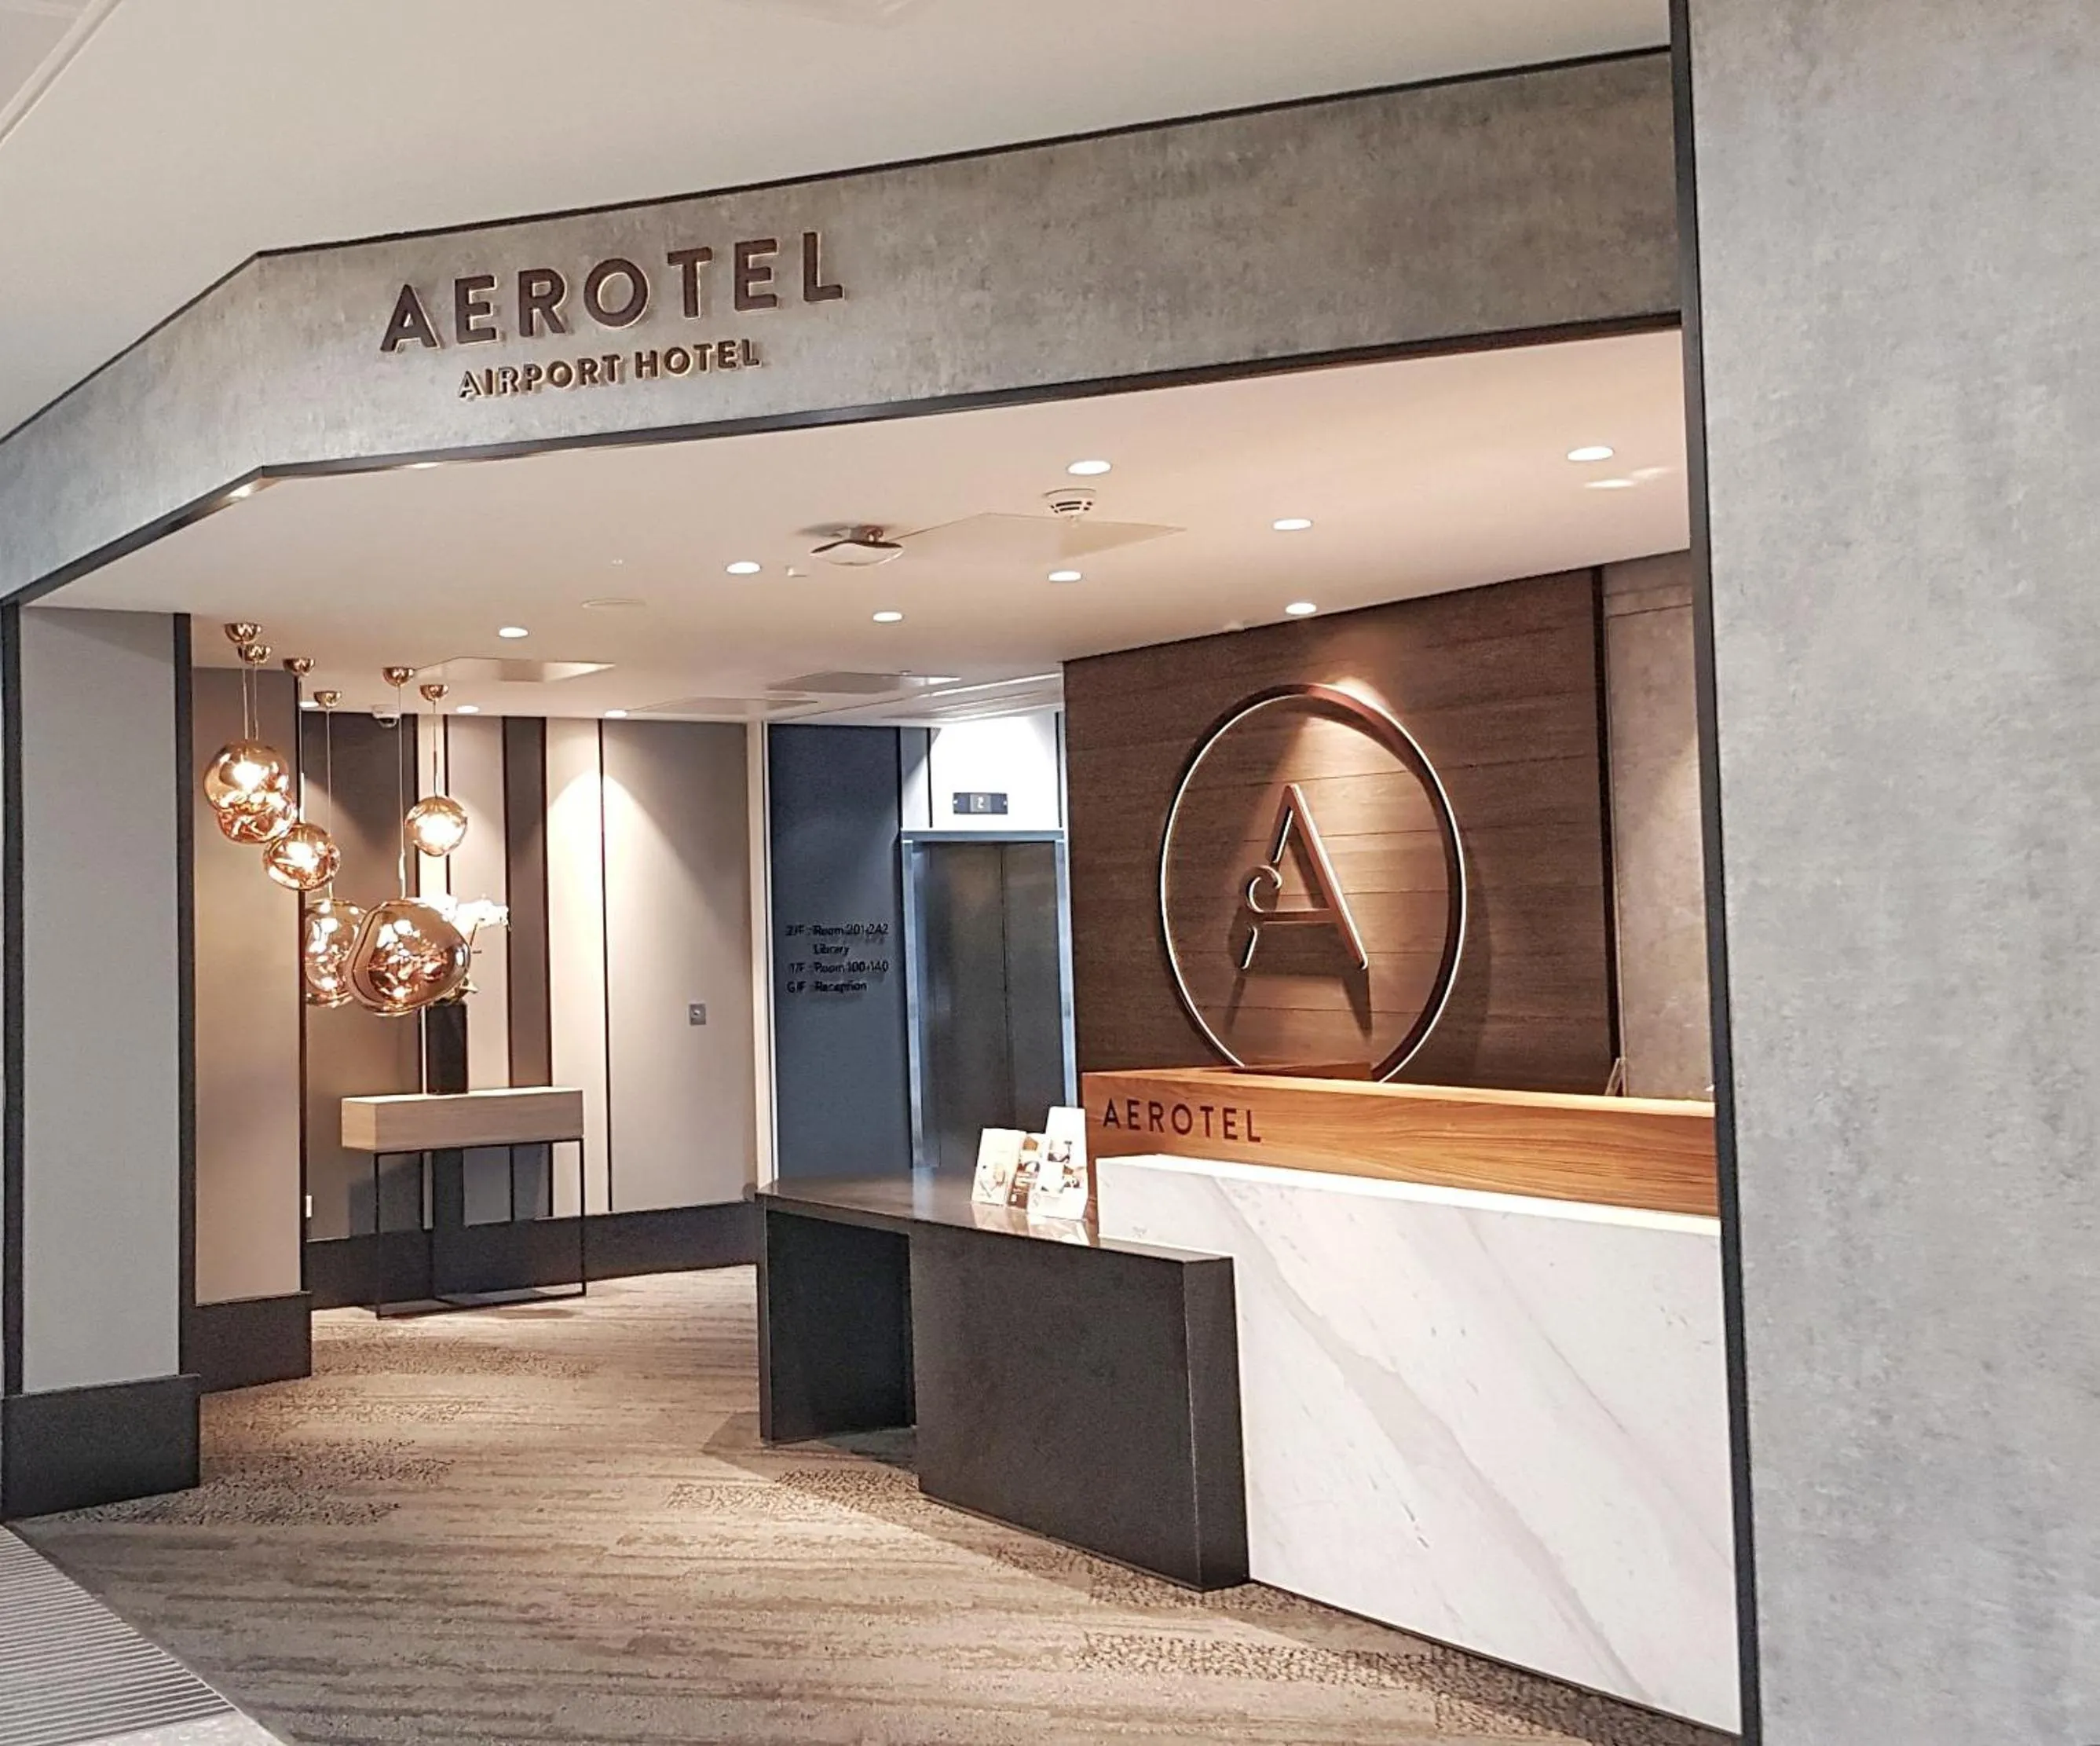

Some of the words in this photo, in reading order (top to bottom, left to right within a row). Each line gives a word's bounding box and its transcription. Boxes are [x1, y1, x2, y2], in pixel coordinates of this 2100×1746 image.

[380, 232, 845, 352] AEROTEL
[458, 353, 622, 401] AIRPORT
[634, 339, 763, 380] HOTEL
[813, 924, 843, 935] Room
[813, 943, 850, 956] Library
[814, 962, 845, 974] Room
[814, 981, 867, 994] Reception
[1103, 1098, 1261, 1143] AEROTEL
